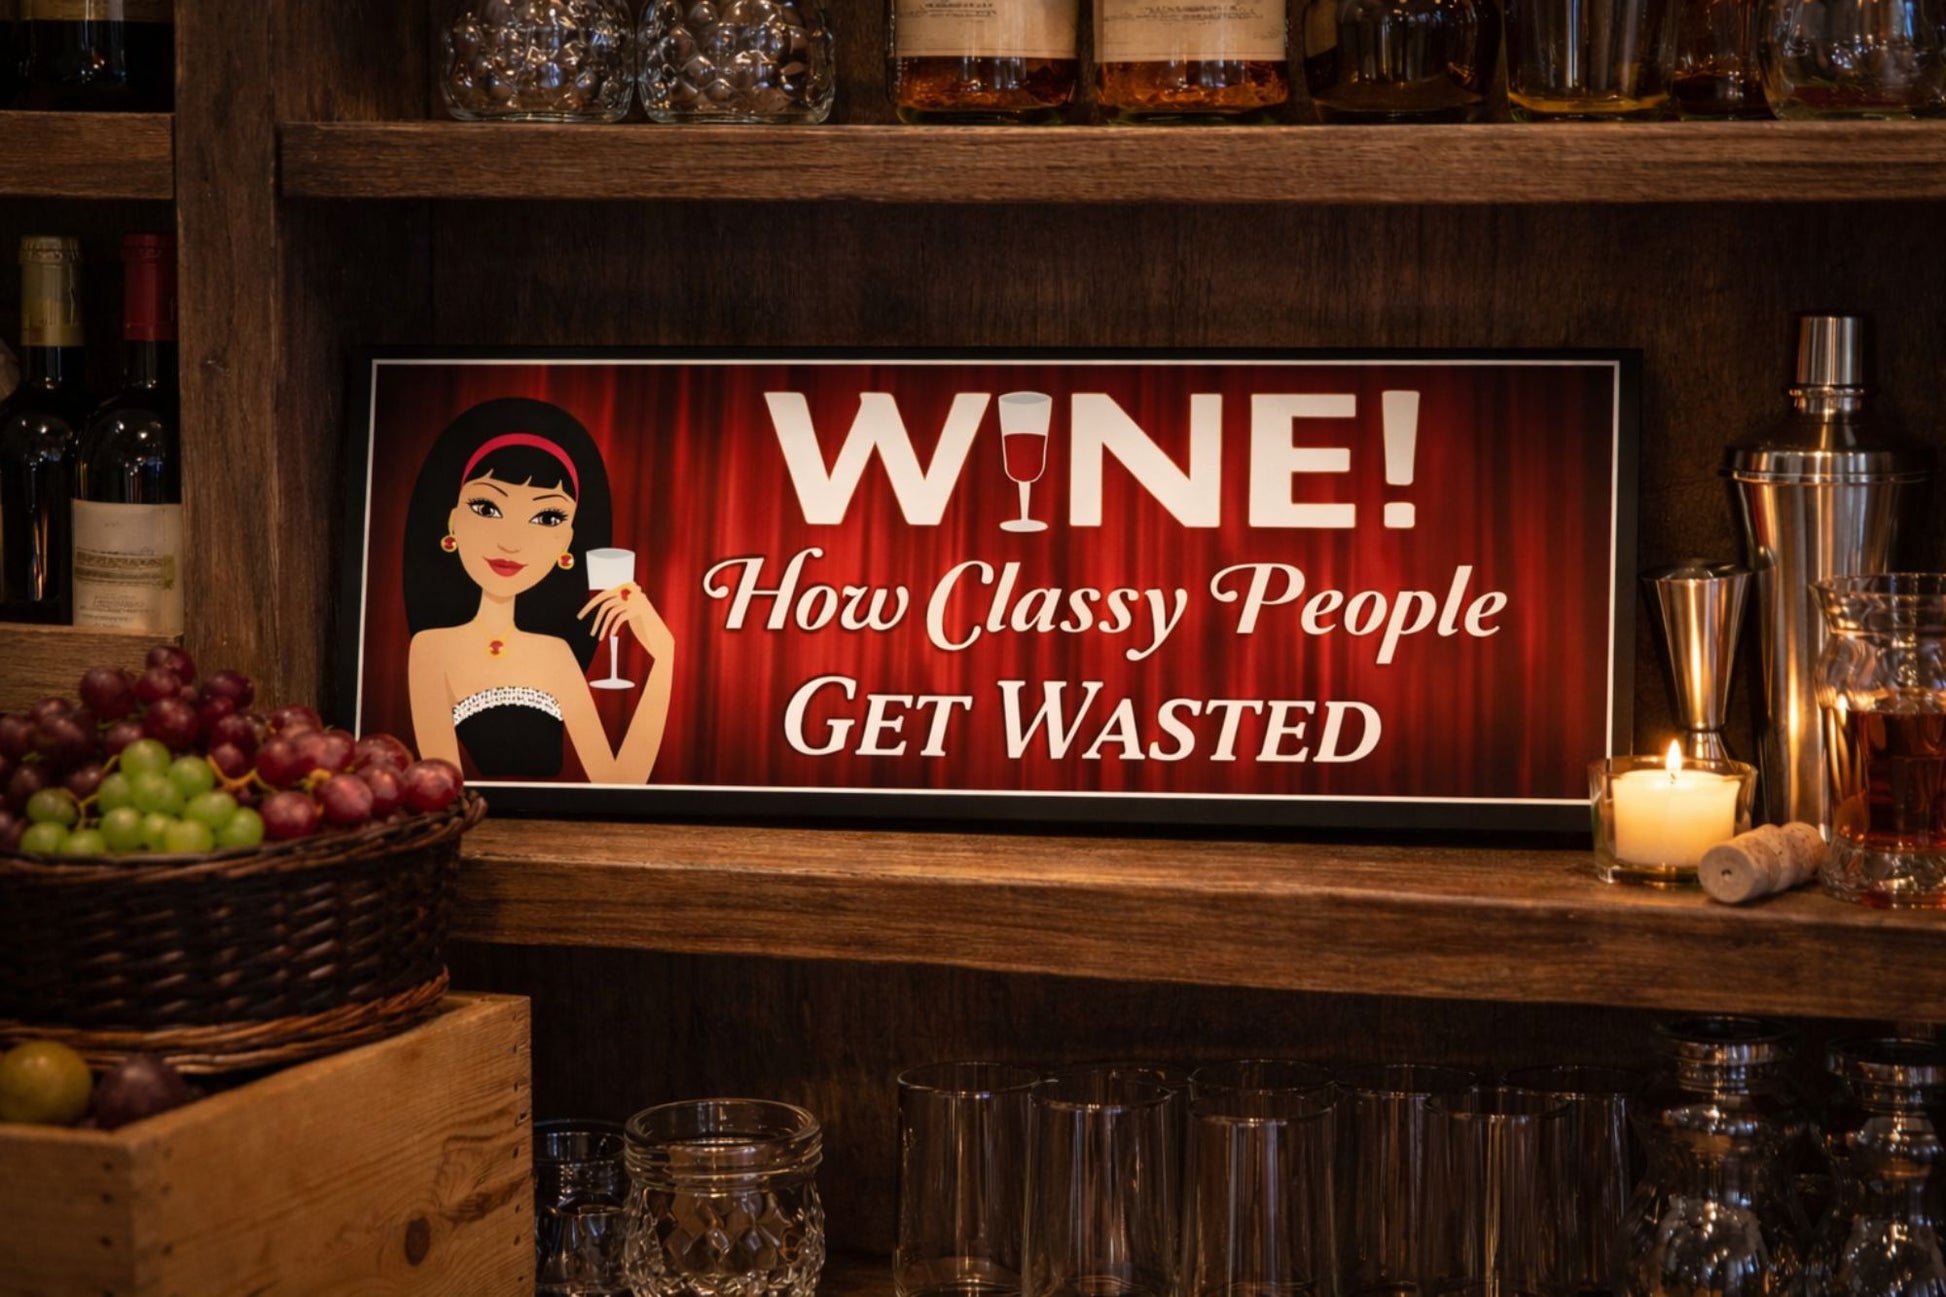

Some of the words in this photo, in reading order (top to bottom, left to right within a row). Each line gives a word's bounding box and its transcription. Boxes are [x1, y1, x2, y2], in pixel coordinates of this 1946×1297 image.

[765, 391, 1420, 532] WINE!
[704, 548, 910, 631] How
[927, 561, 1188, 660] Classy
[1211, 563, 1508, 664] People
